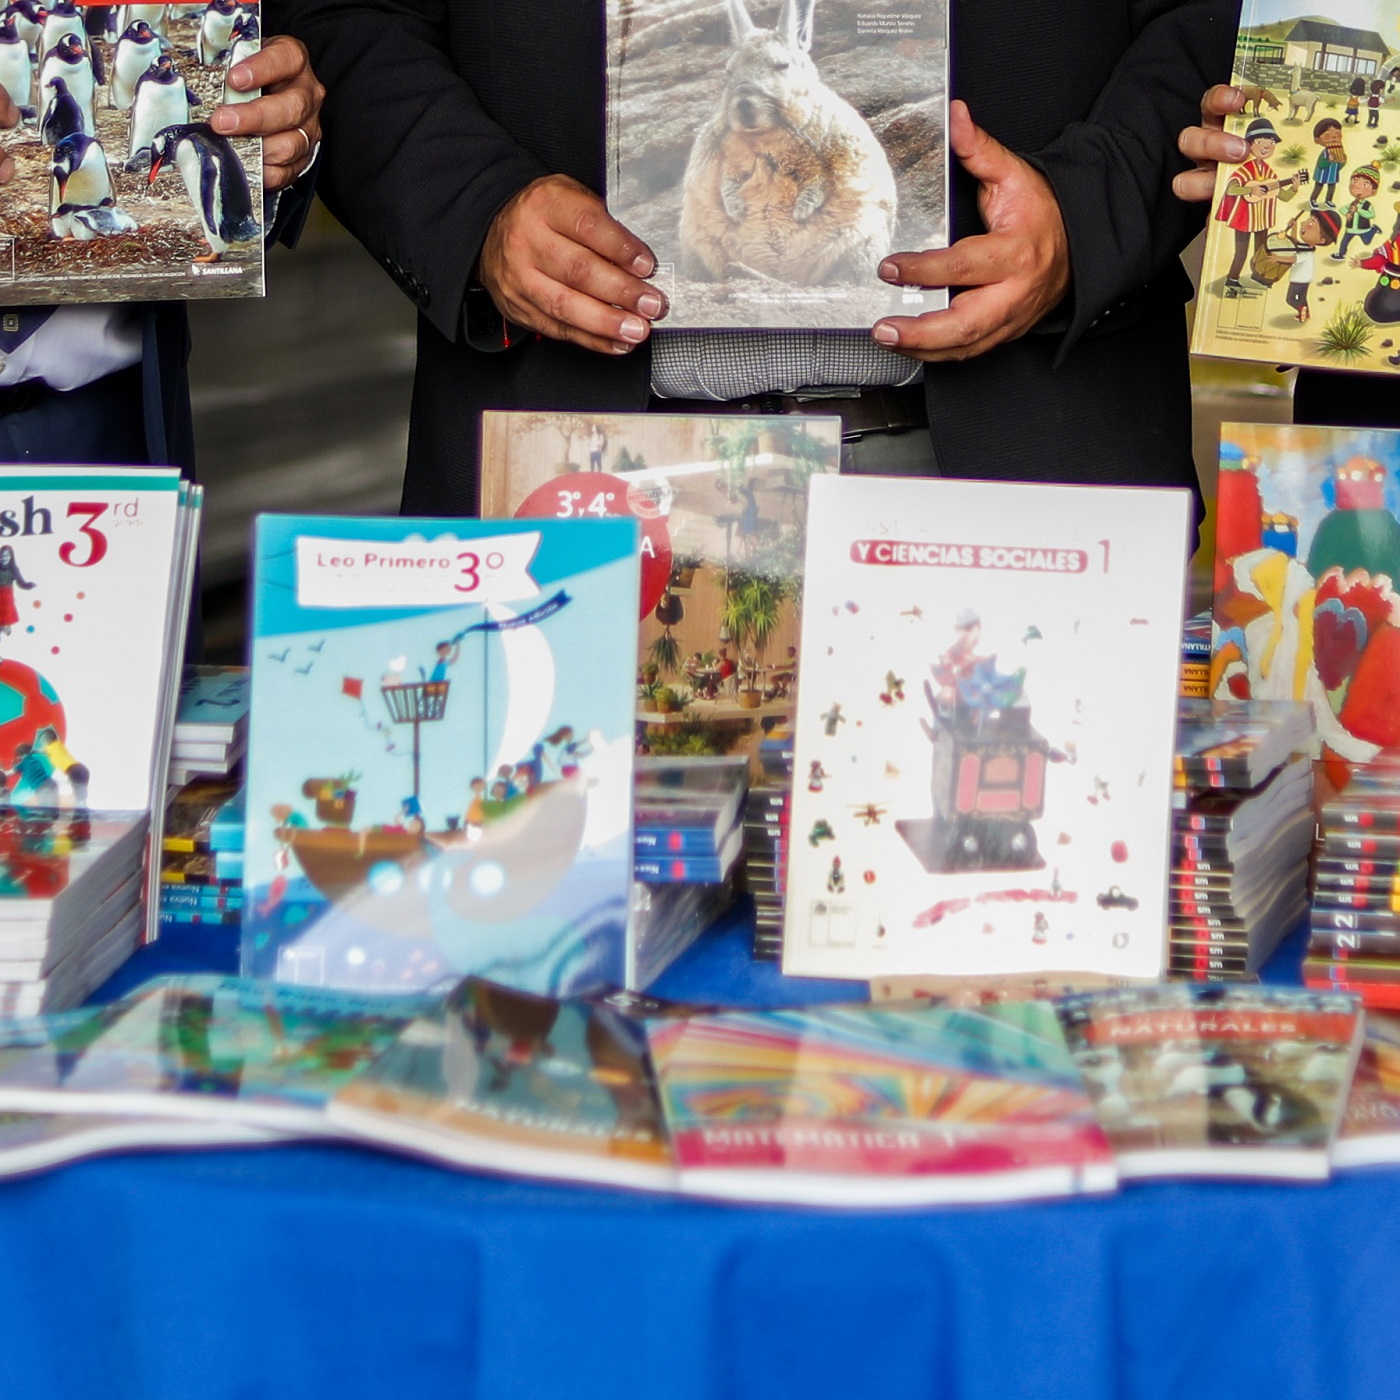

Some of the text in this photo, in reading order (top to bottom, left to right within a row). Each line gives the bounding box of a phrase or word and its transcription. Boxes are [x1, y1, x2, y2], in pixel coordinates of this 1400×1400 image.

[202, 266, 243, 276] SANTILLANA
[317, 552, 355, 568] Leo
[364, 552, 450, 569] Primero
[857, 538, 1111, 575] Y CIENCIAS SOCIALES 1
[1196, 863, 1211, 871] sm
[1194, 878, 1209, 886] sm
[1194, 893, 1208, 901] sm
[1197, 907, 1211, 915] sm
[1207, 919, 1221, 927] sm
[1210, 932, 1225, 940] sm
[1209, 947, 1223, 955] sm
[1209, 961, 1223, 969] sm
